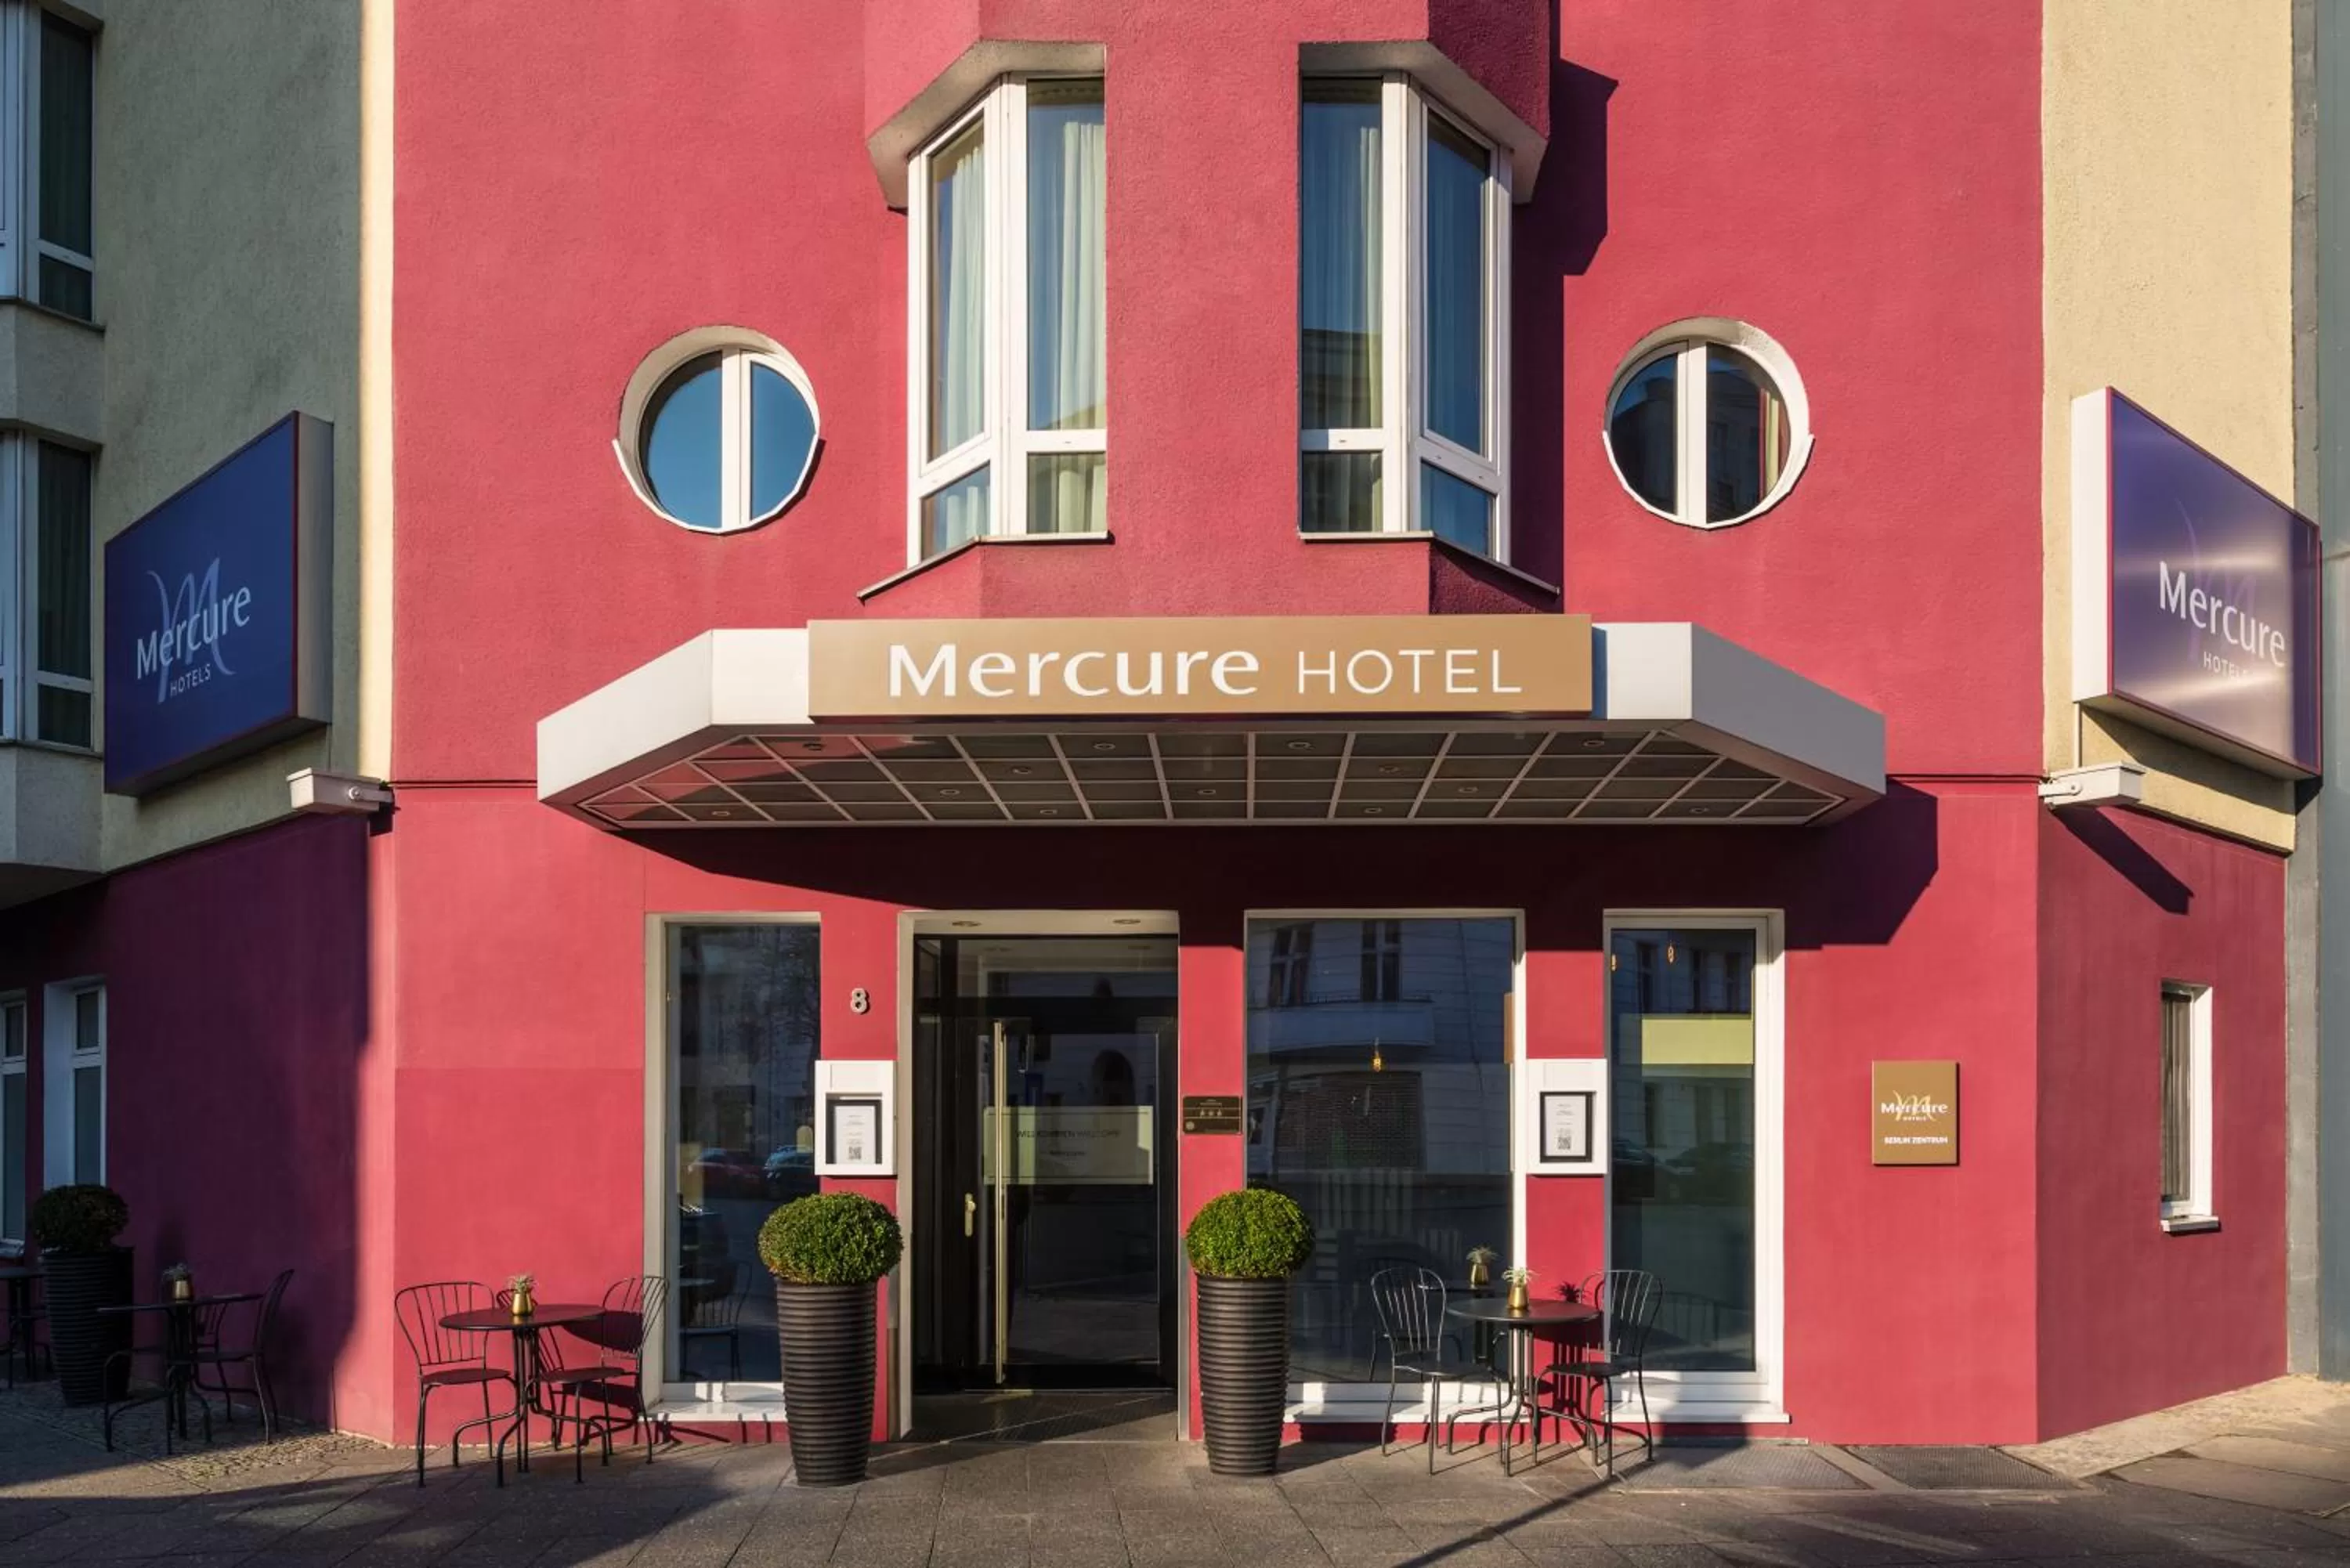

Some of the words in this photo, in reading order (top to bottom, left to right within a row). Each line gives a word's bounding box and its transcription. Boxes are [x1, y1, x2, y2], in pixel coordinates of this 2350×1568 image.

[2160, 561, 2285, 667] Mercure
[137, 587, 251, 680] Mercure
[170, 664, 211, 696] HOTELS
[890, 644, 1259, 697] Mercure
[1298, 649, 1522, 694] HOTEL
[2204, 652, 2251, 680] HOTEL
[850, 988, 867, 1013] 8
[1881, 1102, 1949, 1114] Mercure
